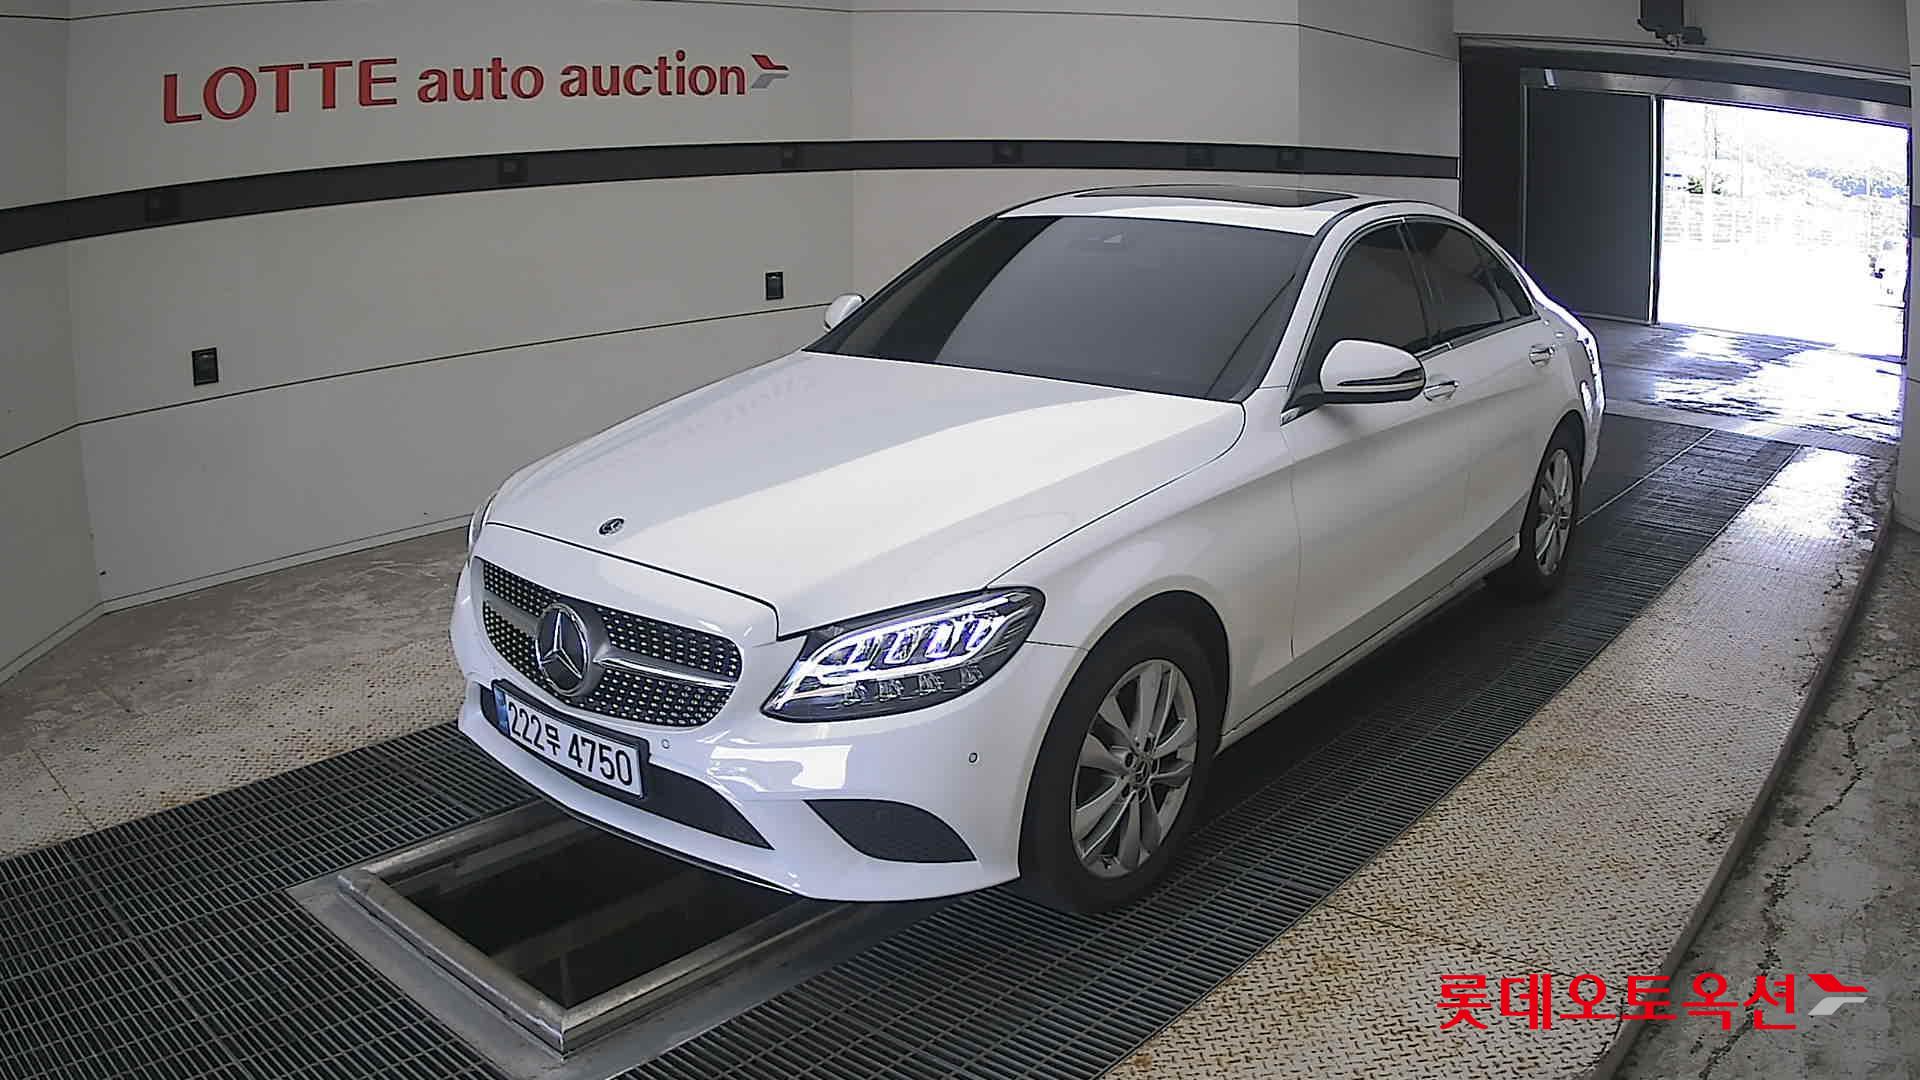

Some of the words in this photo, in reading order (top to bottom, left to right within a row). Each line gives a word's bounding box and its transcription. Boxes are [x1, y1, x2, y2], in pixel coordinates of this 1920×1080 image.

[163, 57, 398, 124] LOTTE
[417, 56, 544, 102] auto
[559, 49, 746, 97] auction
[508, 701, 560, 756] 222무
[568, 733, 633, 786] 4750
